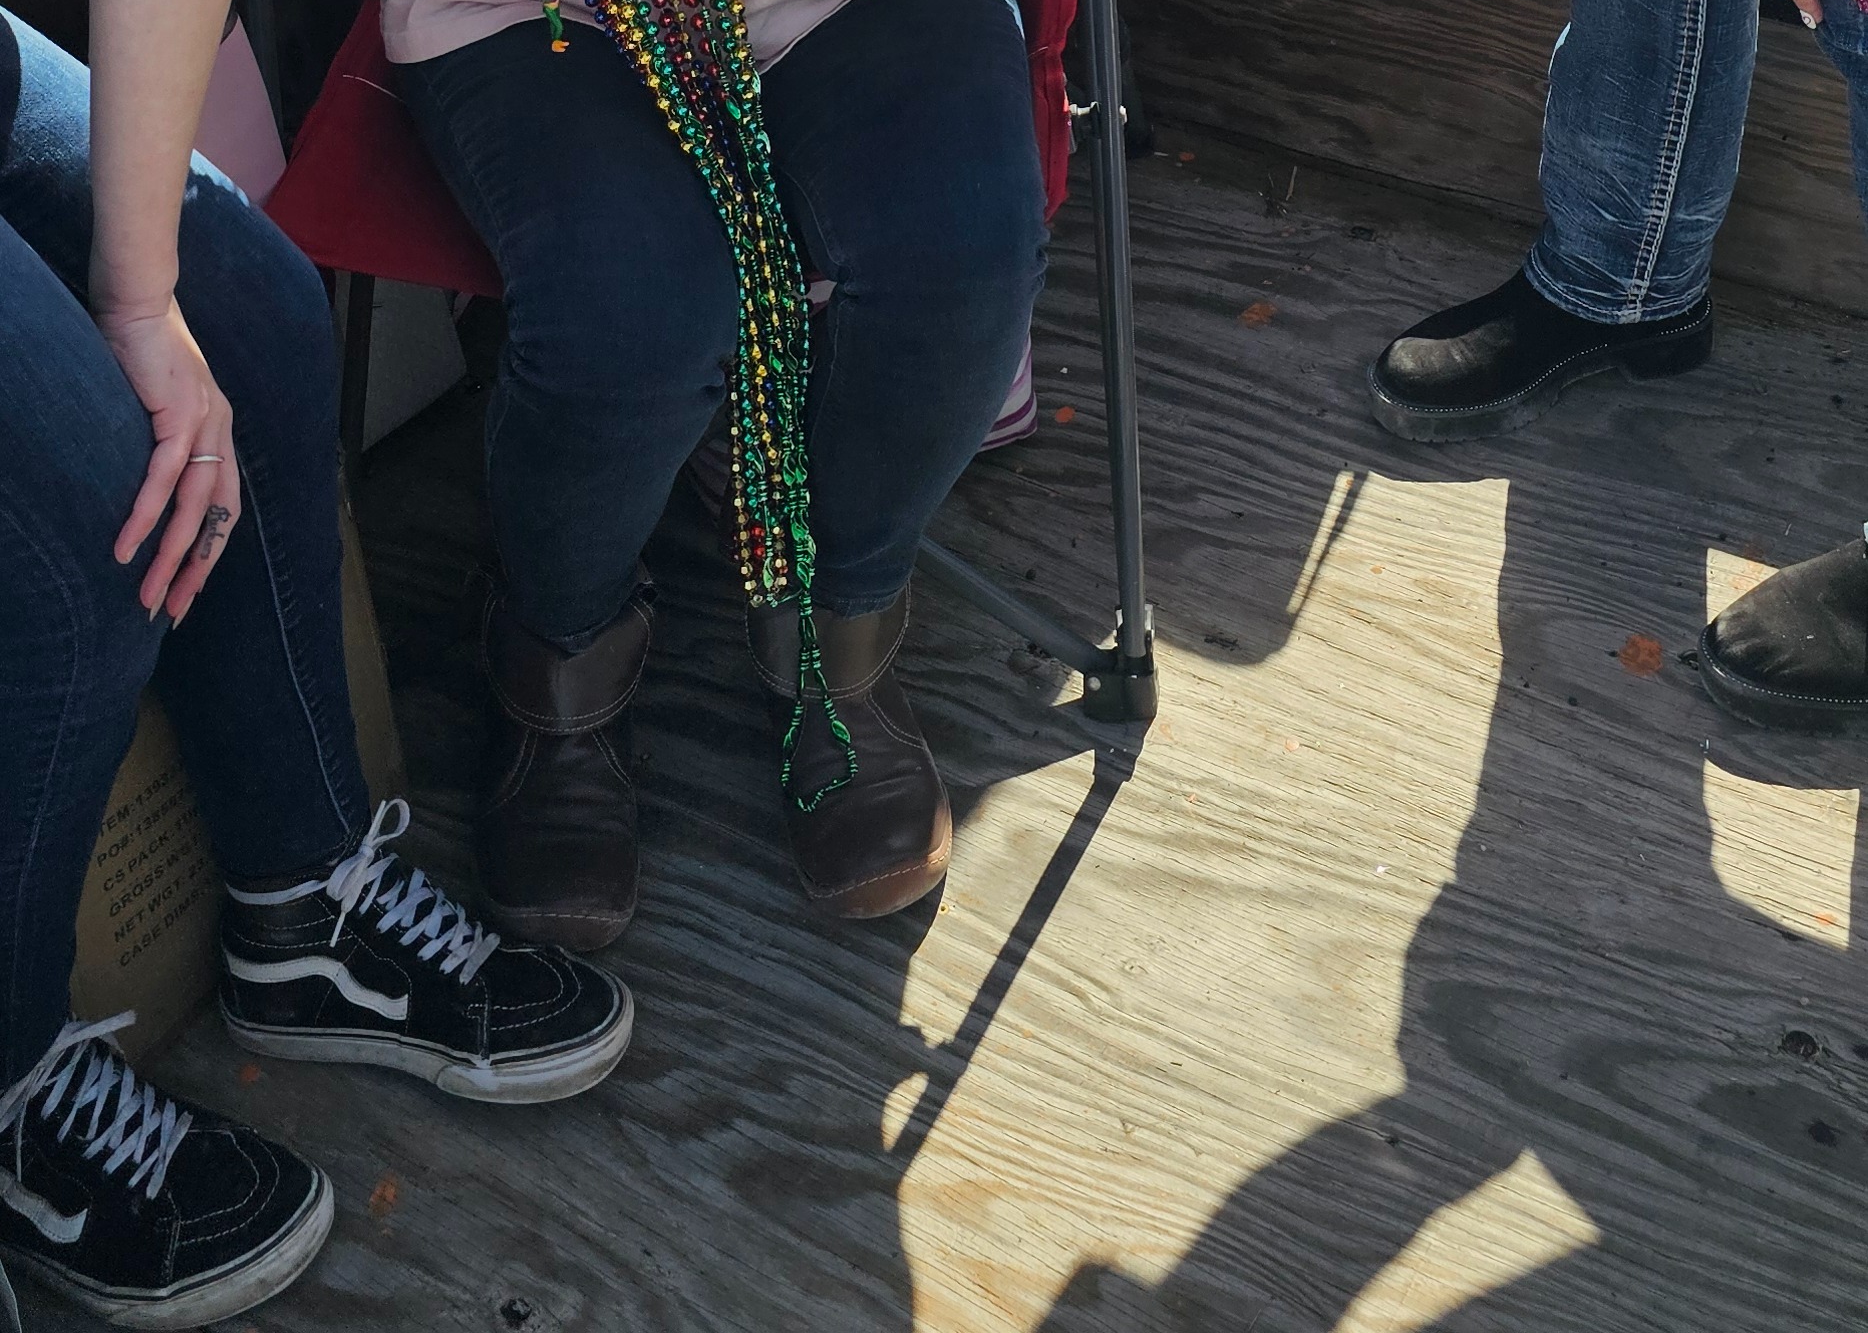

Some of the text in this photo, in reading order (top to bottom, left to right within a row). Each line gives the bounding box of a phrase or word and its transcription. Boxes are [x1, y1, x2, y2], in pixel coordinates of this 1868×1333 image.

[103, 869, 126, 892] CS
[110, 865, 164, 918] GROSS
[114, 909, 145, 943] NET
[120, 924, 161, 967] CASE
